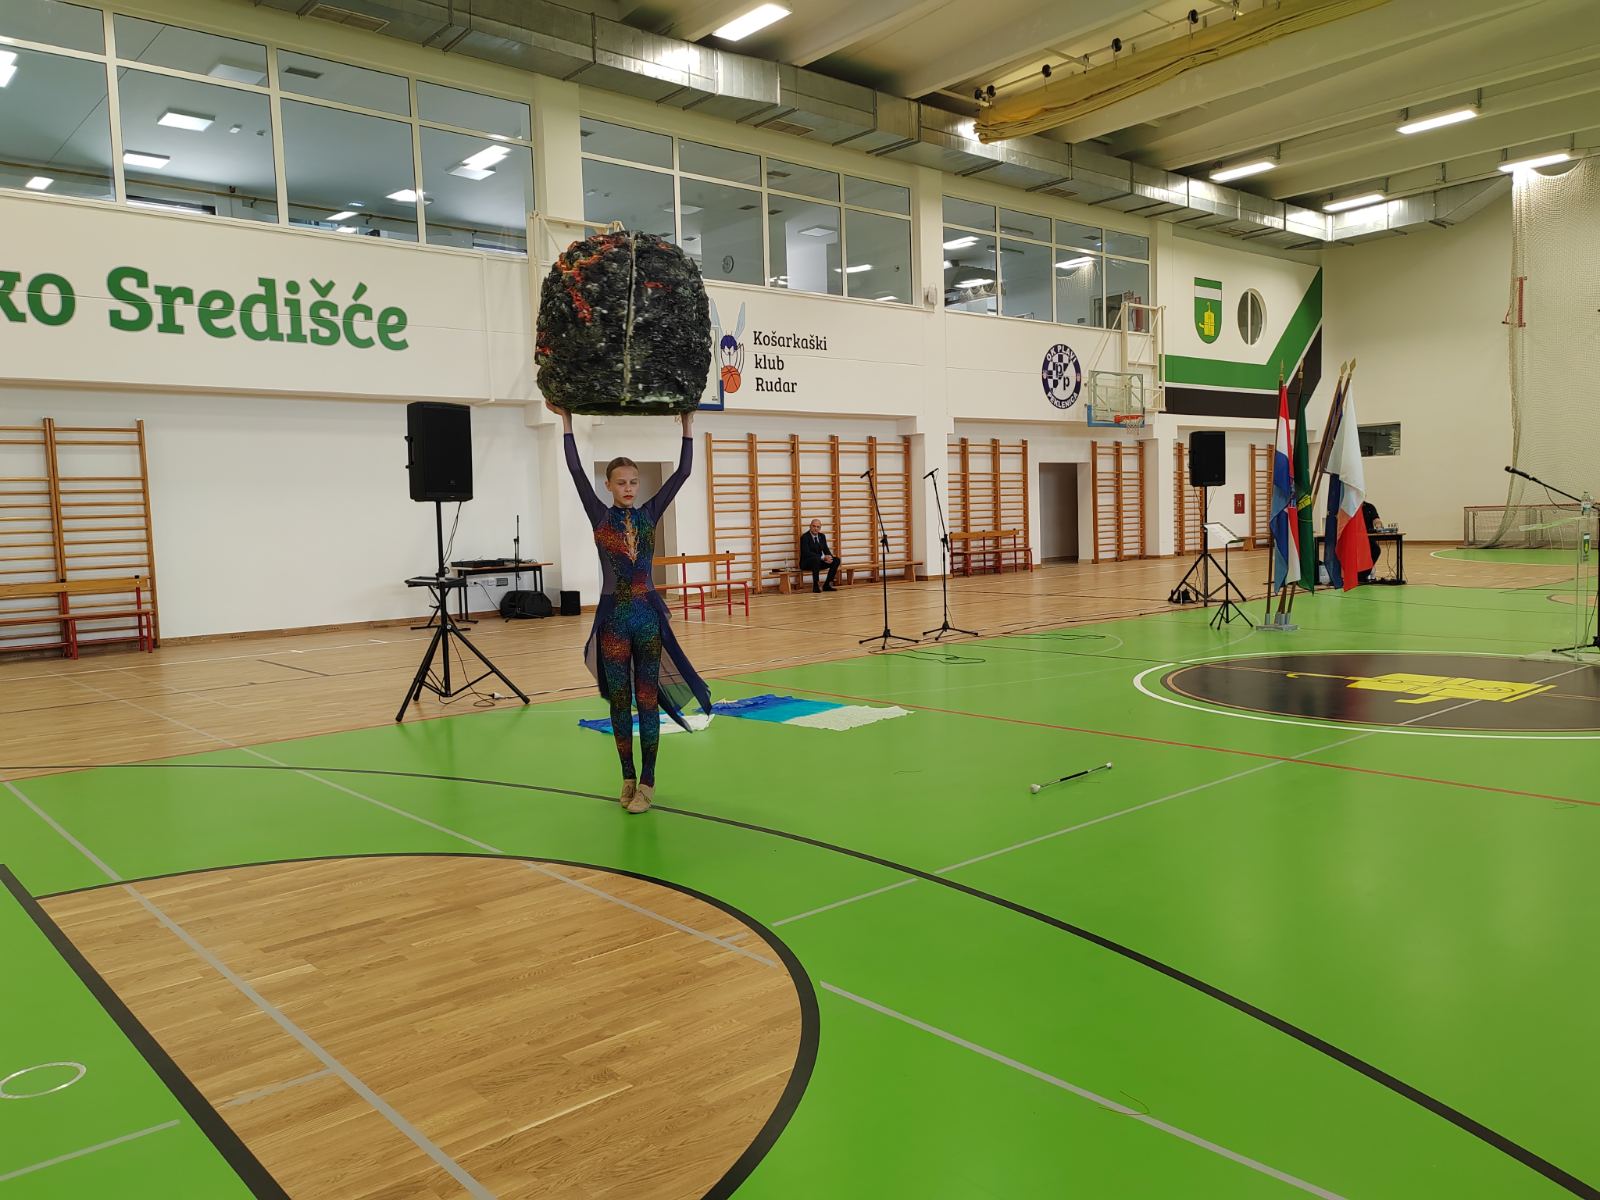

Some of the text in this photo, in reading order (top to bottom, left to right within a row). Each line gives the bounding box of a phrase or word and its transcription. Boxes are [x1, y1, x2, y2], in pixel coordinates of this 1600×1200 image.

[106, 266, 409, 351] Središće
[753, 330, 828, 351] Košarkaški
[754, 353, 785, 371] klub
[755, 377, 798, 393] Rudar
